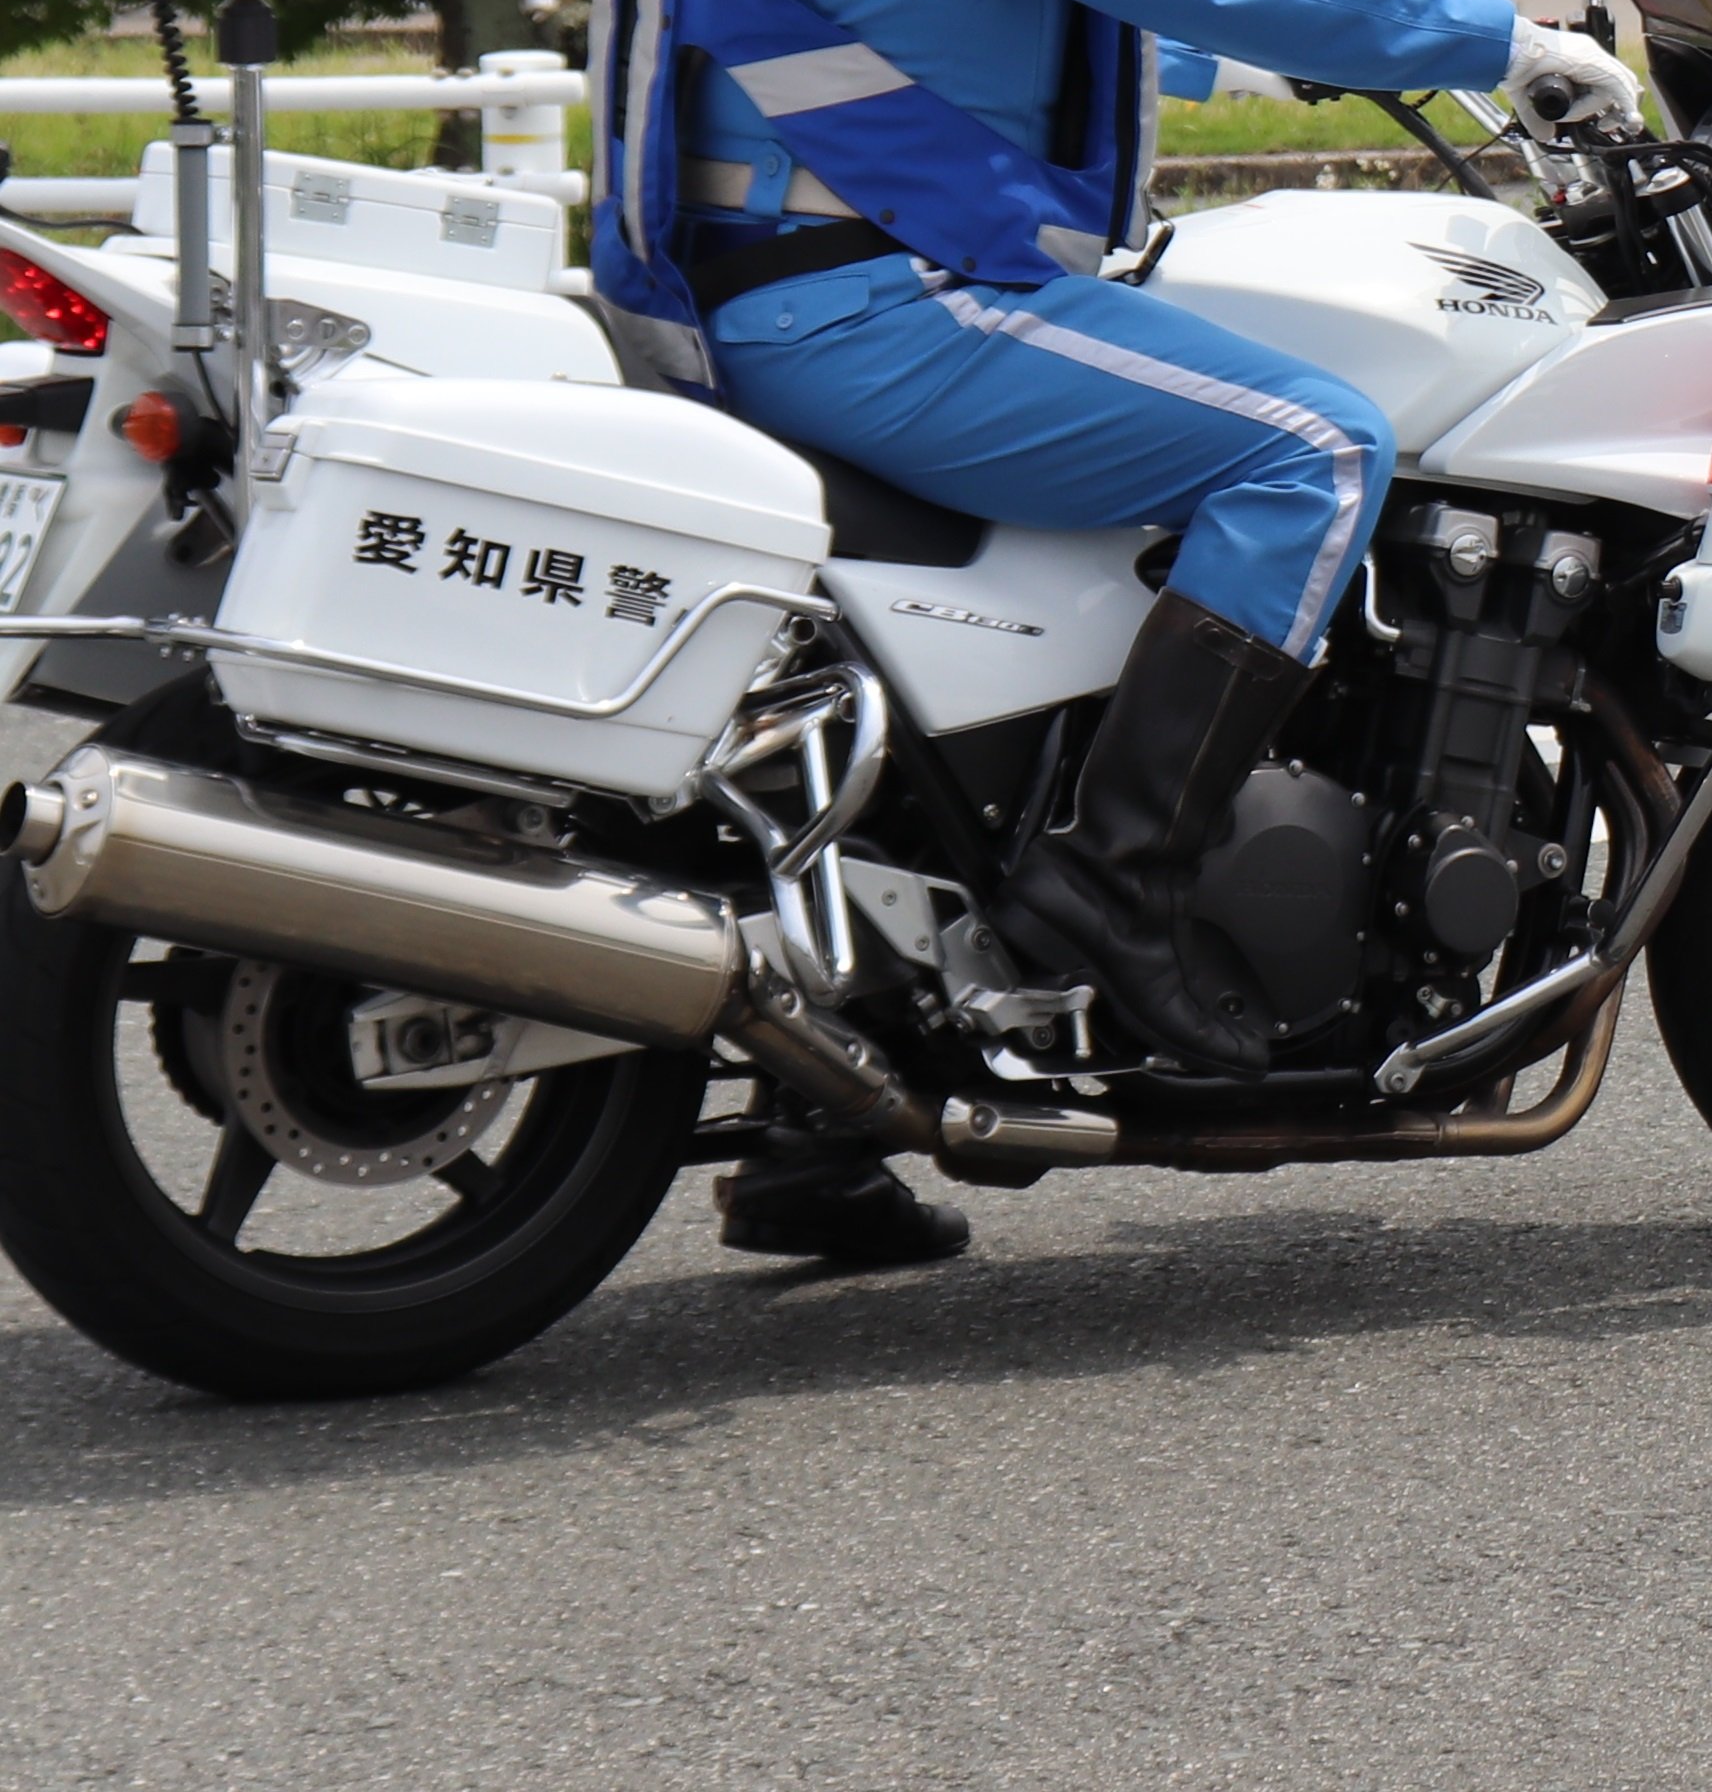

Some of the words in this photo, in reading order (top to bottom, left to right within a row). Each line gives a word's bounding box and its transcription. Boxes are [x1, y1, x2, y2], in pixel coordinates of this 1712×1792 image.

[1434, 298, 1558, 326] HONDA
[352, 509, 673, 628] 愛知県警
